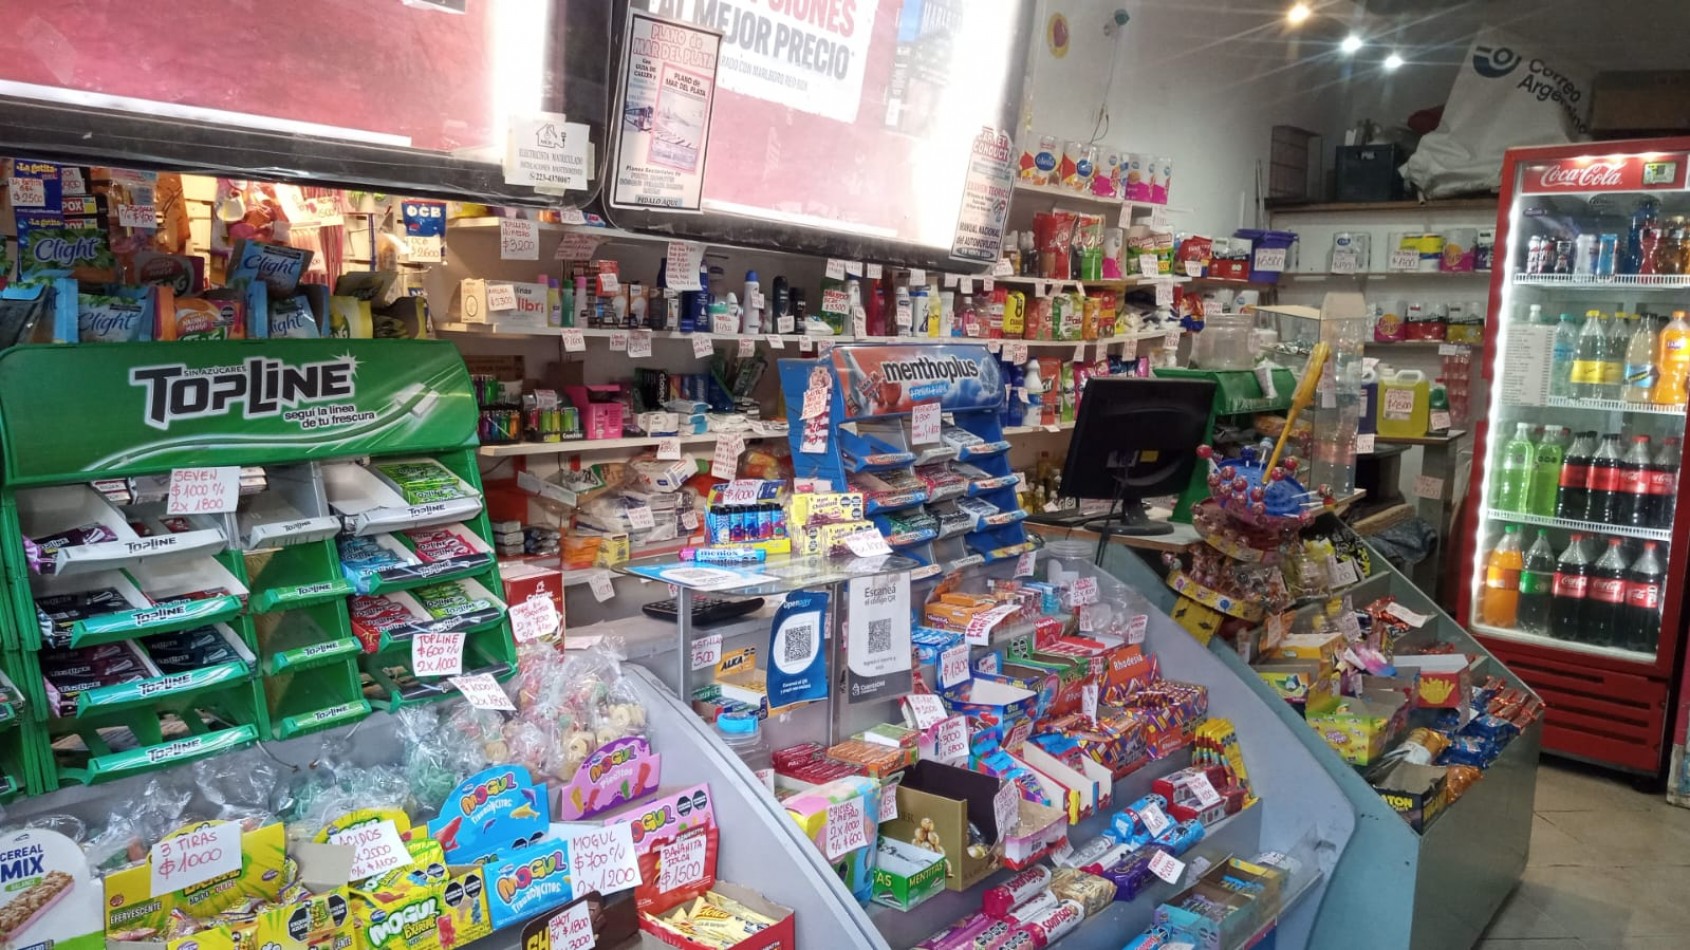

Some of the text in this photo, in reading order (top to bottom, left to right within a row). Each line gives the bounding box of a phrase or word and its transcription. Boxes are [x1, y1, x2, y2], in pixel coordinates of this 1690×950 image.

[651, 23, 687, 45] PLANO
[692, 0, 850, 81] MEJOR PRECIO
[682, 48, 716, 71] PLATA
[674, 72, 692, 85] PLANO
[1529, 58, 1581, 103] Correo
[1540, 162, 1627, 187] Coca-Cola
[406, 204, 442, 218] OCB
[35, 237, 99, 266] Clight
[243, 252, 301, 276] Clight
[78, 312, 139, 337] Clight
[183, 364, 247, 377] SIN AZÚCARES
[882, 357, 979, 383] menthoplus
[284, 404, 355, 421] seguí la línea
[301, 411, 376, 429] de tu frescura
[174, 470, 218, 482] SEVEN
[193, 499, 224, 511] 1800
[408, 503, 446, 518] TOPLINE
[283, 520, 312, 532] TOPLINE
[125, 536, 177, 554] TOPLINE
[296, 583, 332, 595] TOPLINE
[133, 604, 187, 626] TOPLINE
[304, 641, 338, 657] TOPLINE
[417, 634, 460, 645] TOPLINE
[435, 658, 458, 672] 1000
[720, 656, 744, 672] ALKA
[1113, 652, 1144, 672] Rhodesia
[138, 673, 192, 696] TOPLINE
[314, 704, 349, 720] TOPLINE
[147, 739, 200, 762] TOPLINE
[590, 744, 637, 784] MOGUL
[461, 772, 519, 816] MOGUL
[631, 805, 676, 844] OGUL
[160, 831, 218, 858] 3 TIRAS
[573, 829, 617, 852] MOGUL
[0, 843, 44, 862] CEREAL
[158, 848, 223, 880] $1000
[0, 853, 45, 884] MIX
[497, 850, 569, 905] MOGUL
[599, 867, 636, 891] 1200
[660, 860, 702, 892] $1500
[909, 861, 944, 888] MENTITAS
[110, 900, 163, 926] EFERVESCENTE
[368, 897, 442, 948] MOGUL
[1042, 906, 1073, 933] Sonrisas
